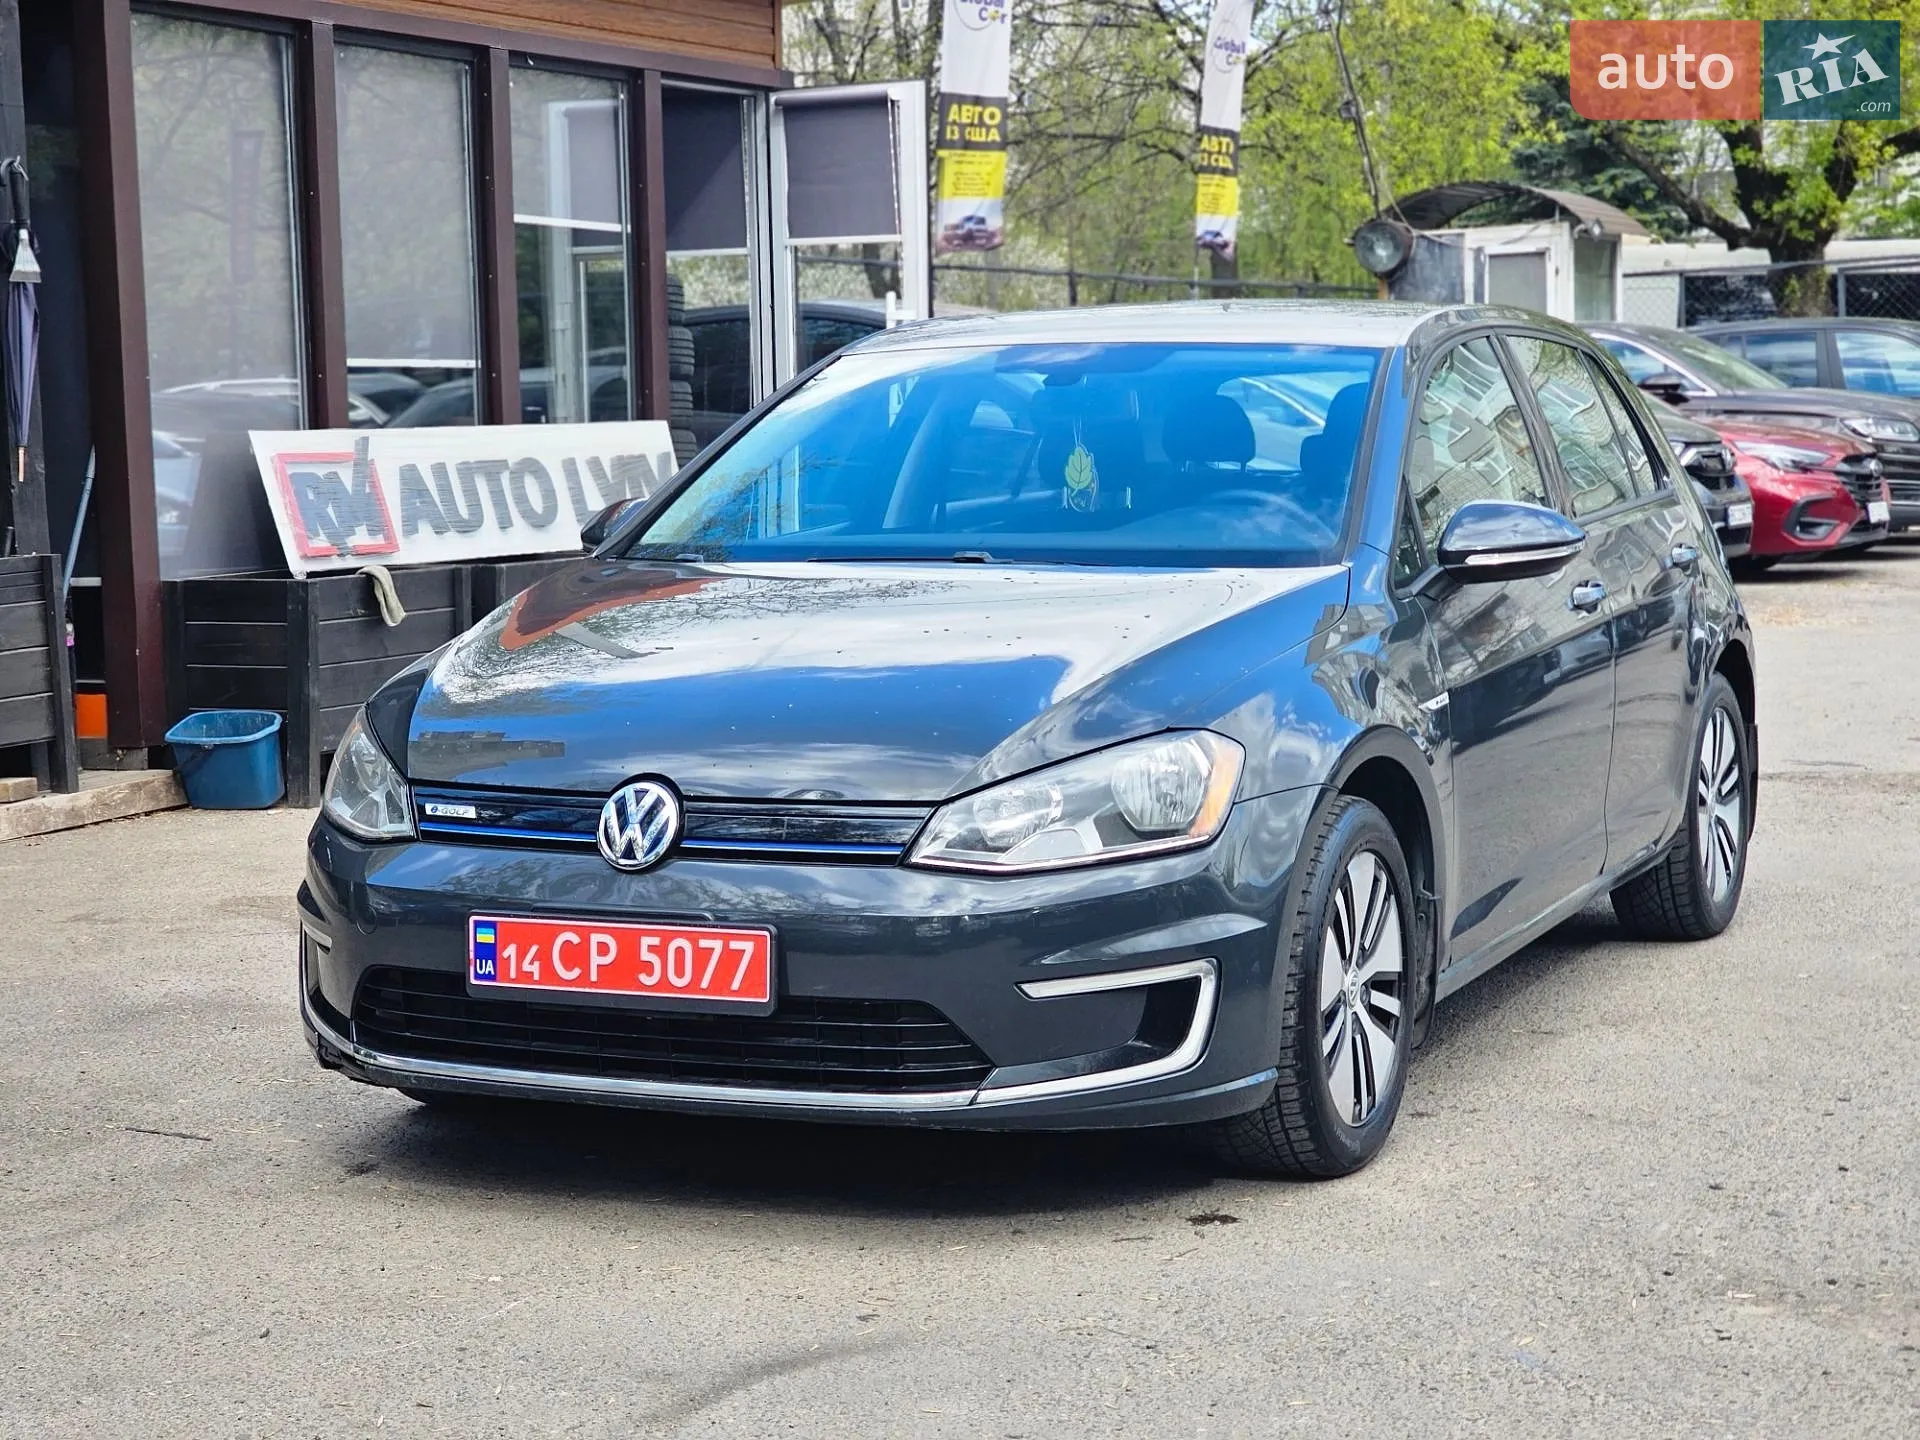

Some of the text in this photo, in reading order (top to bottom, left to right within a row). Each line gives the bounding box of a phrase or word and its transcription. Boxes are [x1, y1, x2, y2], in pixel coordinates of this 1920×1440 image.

[400, 456, 559, 536] AUTO
[476, 959, 495, 976] UA
[501, 943, 541, 981] 14
[638, 936, 756, 992] 5077
